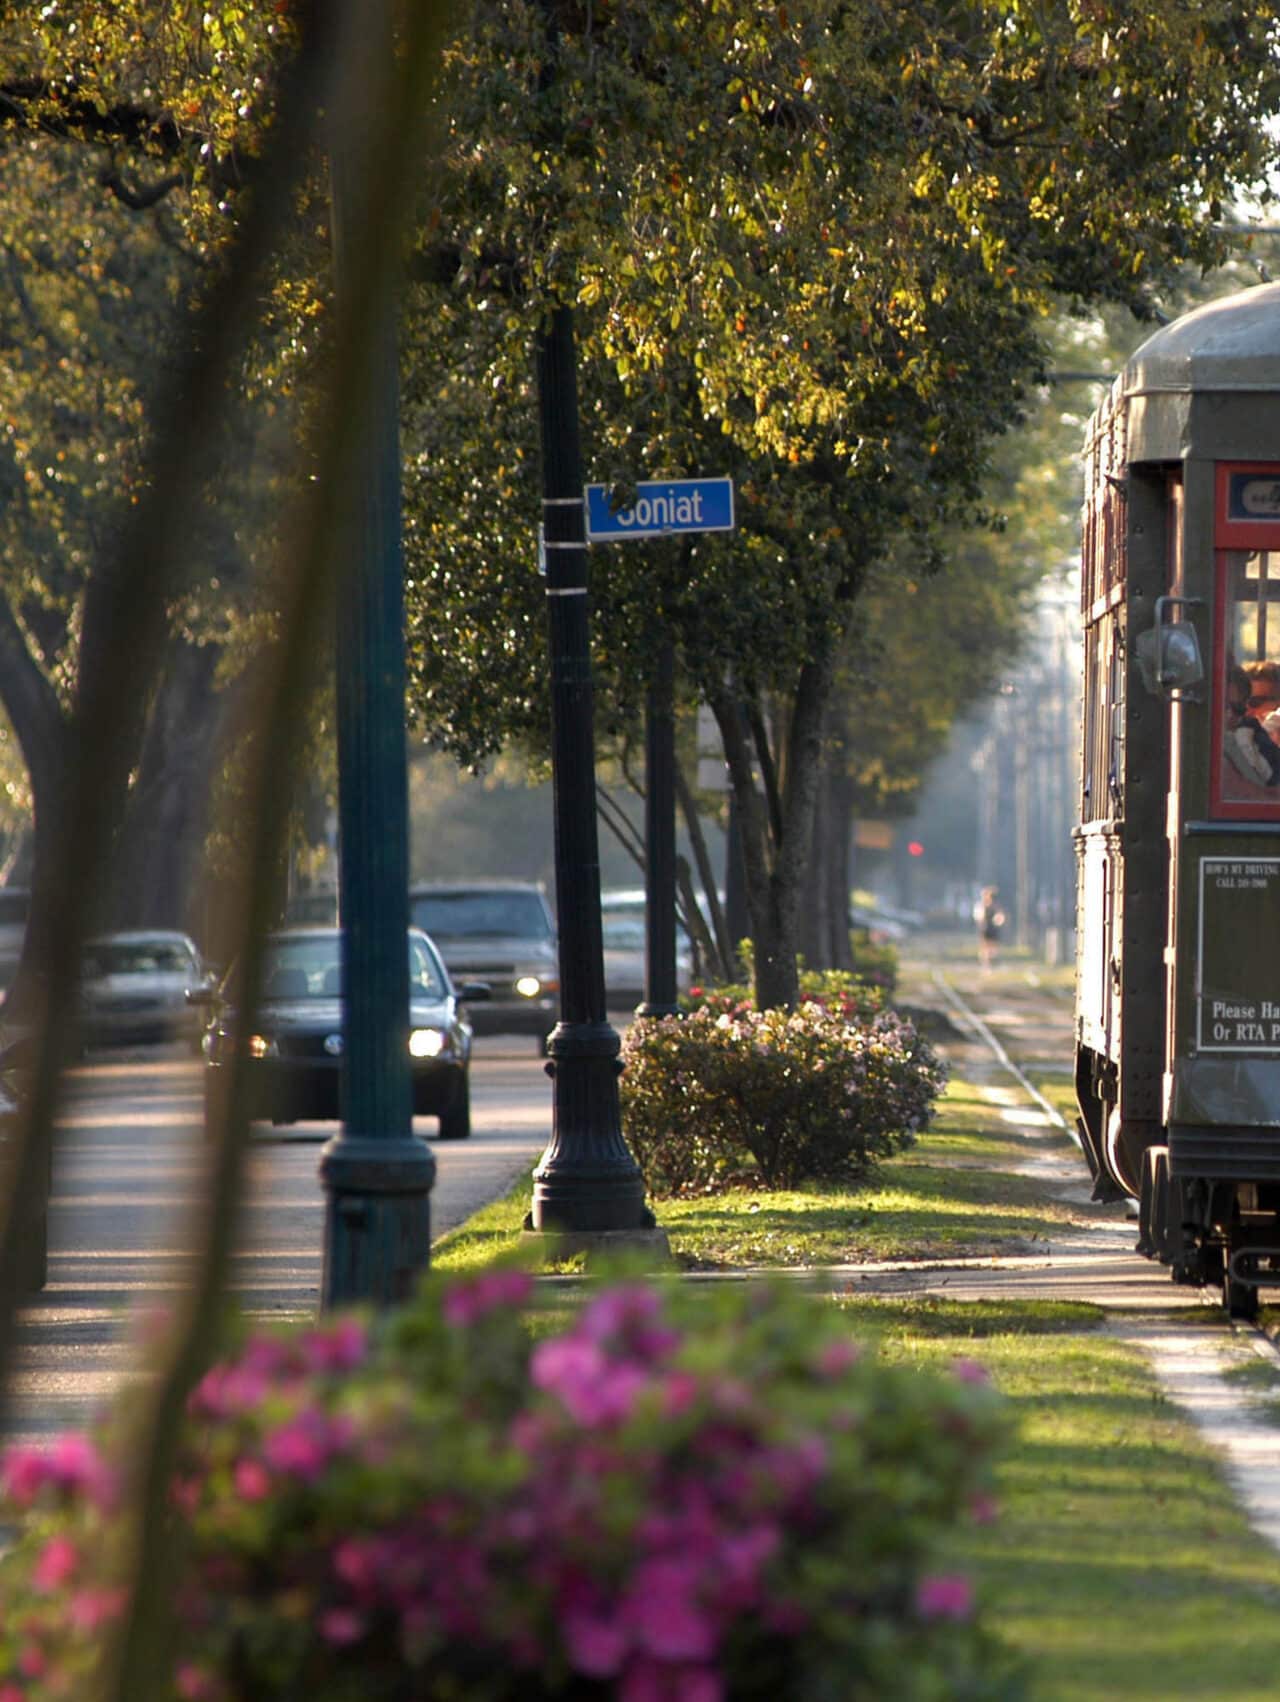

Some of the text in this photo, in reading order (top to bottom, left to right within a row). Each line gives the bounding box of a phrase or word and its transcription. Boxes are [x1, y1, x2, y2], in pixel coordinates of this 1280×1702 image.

[1213, 1002, 1255, 1019] Please
[1214, 1023, 1230, 1041] Or
[1236, 1024, 1265, 1041] RTA
